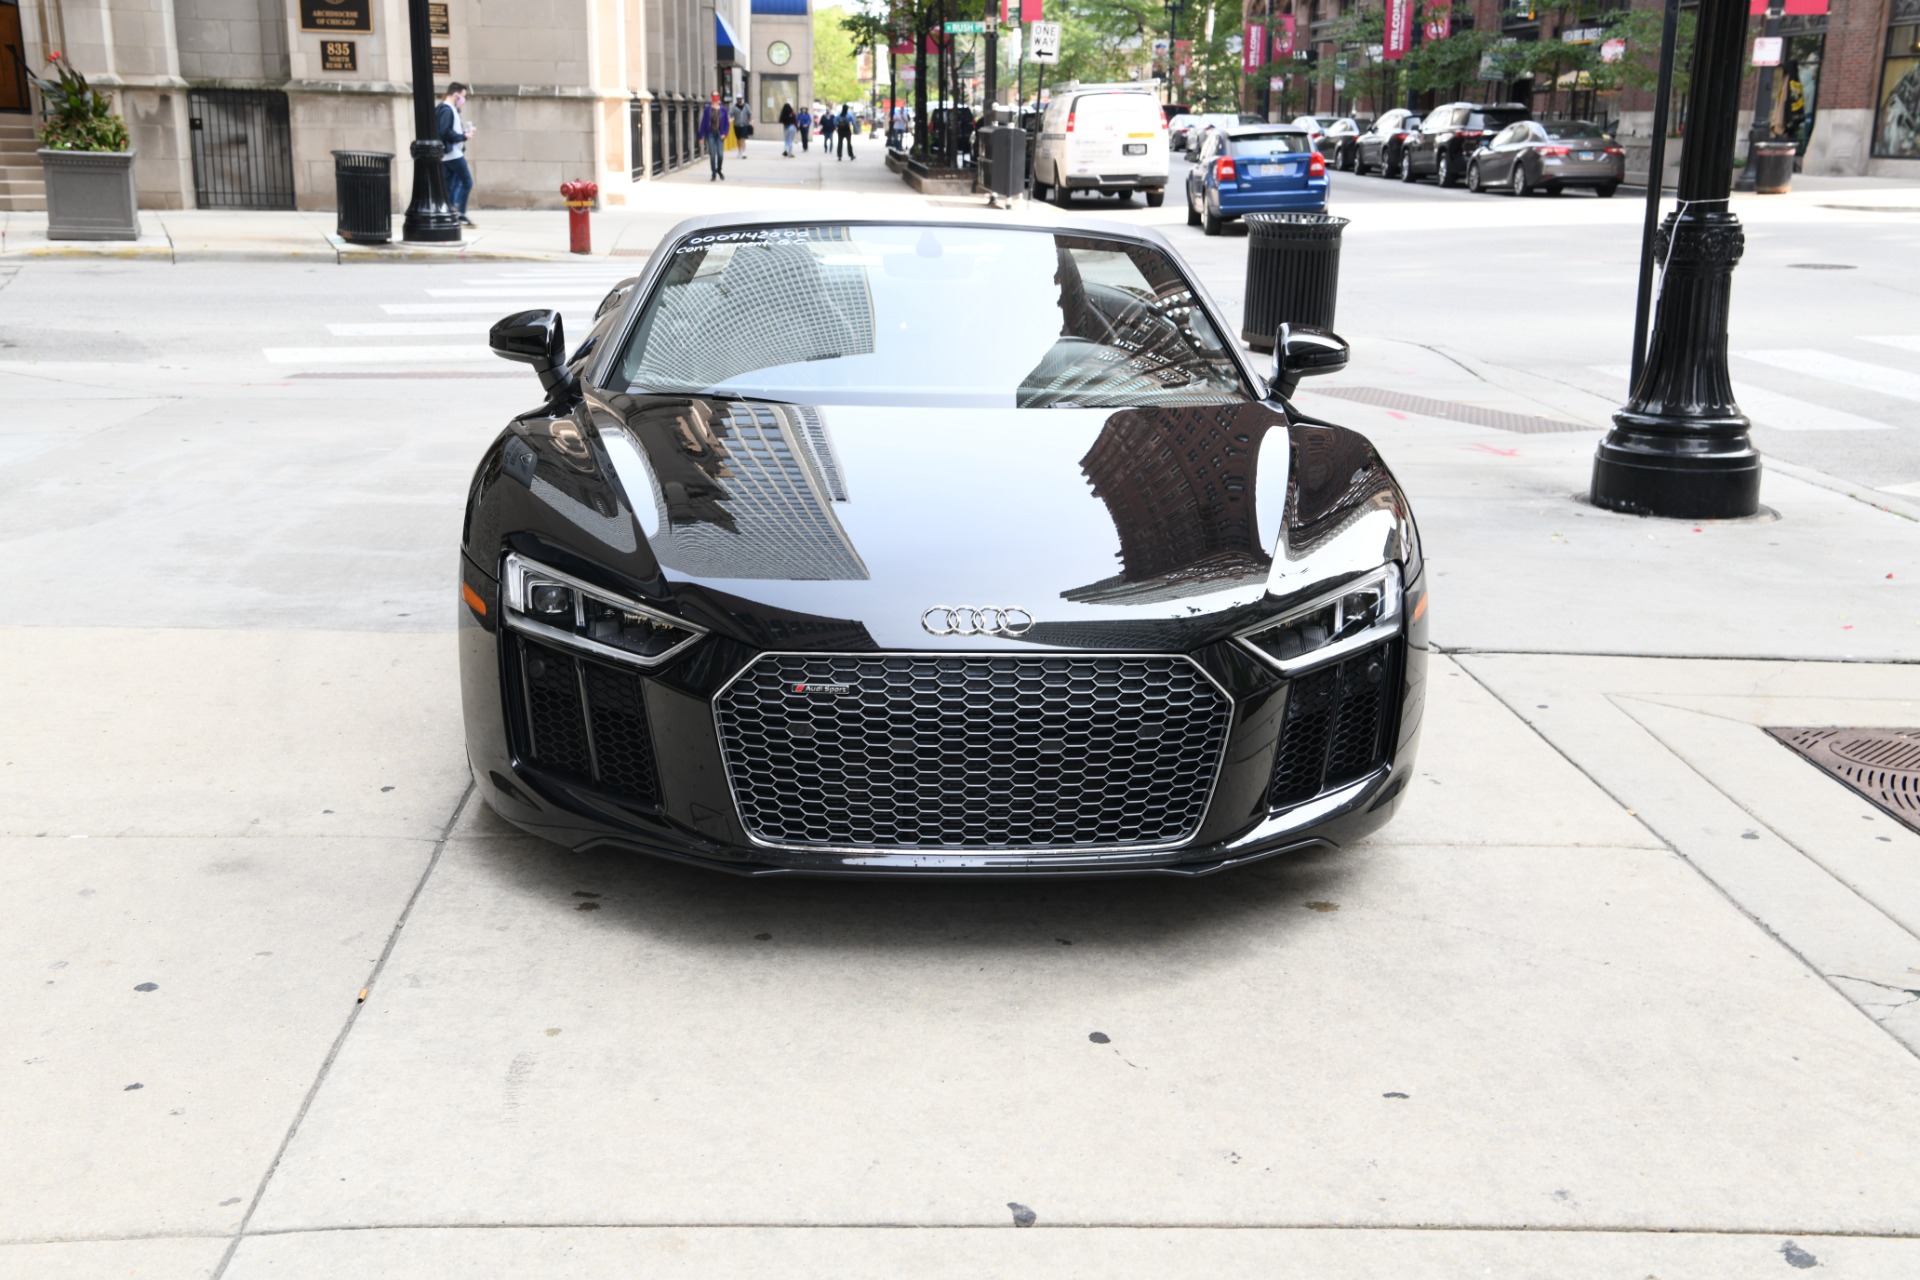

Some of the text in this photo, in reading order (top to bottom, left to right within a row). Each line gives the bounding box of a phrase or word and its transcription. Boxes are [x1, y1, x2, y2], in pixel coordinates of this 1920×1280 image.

[312, 10, 359, 18] ARCHDIOCESE
[327, 18, 355, 26] CHICAGO
[952, 23, 973, 32] RUSH
[1035, 25, 1056, 36] ONE
[1034, 37, 1056, 47] WAY
[327, 42, 350, 56] 835
[824, 685, 846, 693] Sport
